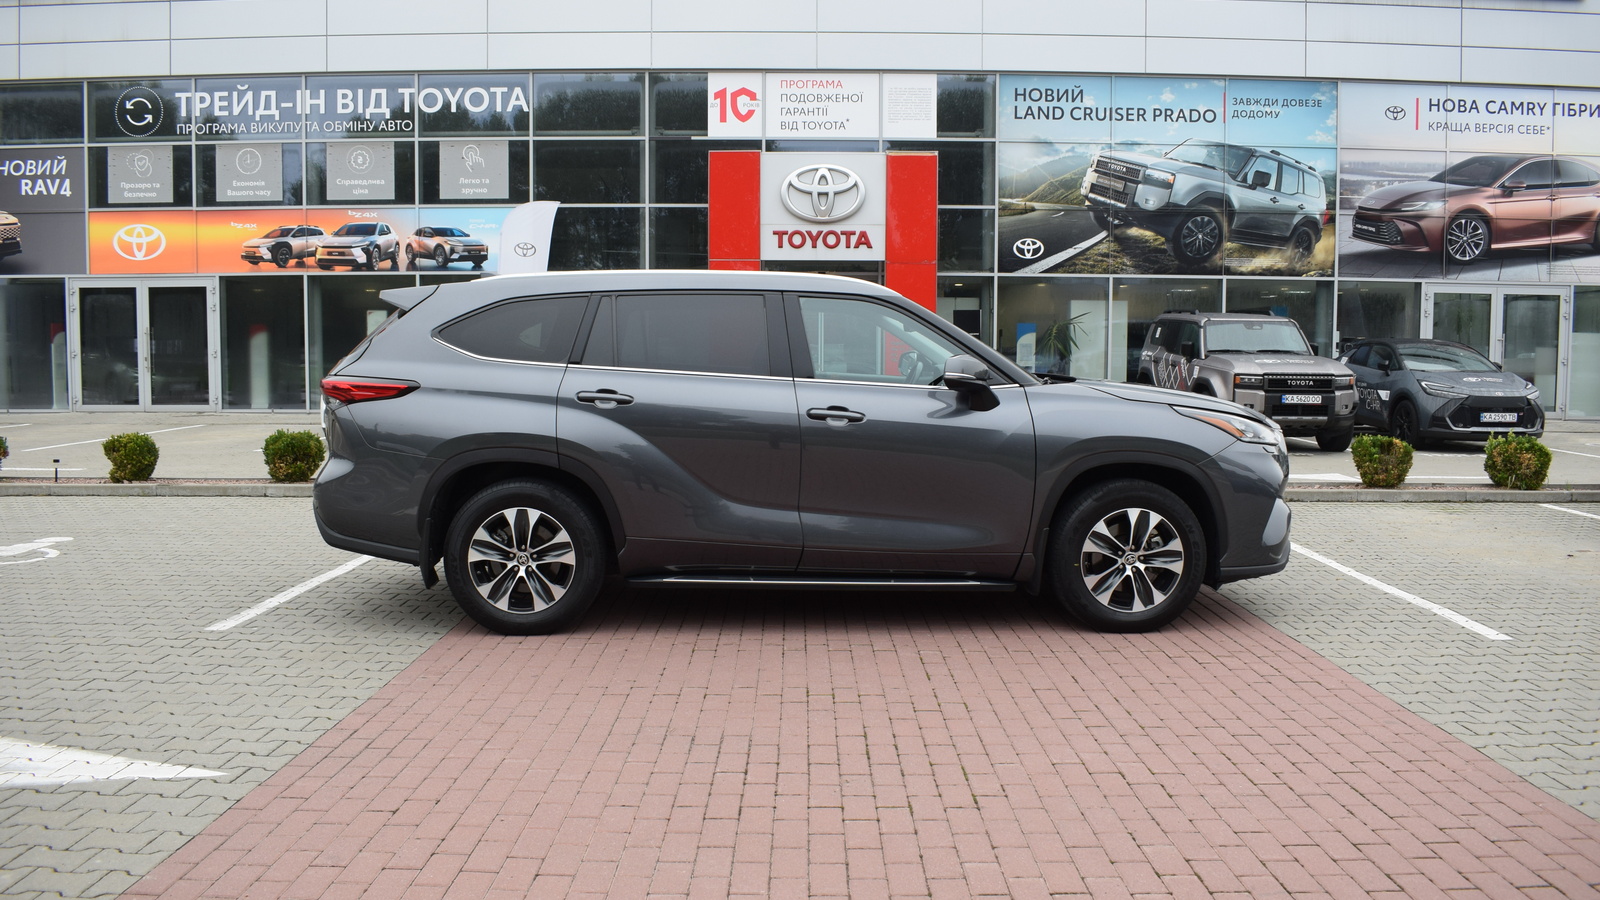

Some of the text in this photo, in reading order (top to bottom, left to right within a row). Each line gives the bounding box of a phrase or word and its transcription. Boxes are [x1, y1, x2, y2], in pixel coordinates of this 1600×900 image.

[780, 79, 844, 89] ПРОГРАМА
[780, 91, 864, 104] ПОДОВЖЕНОЇ
[1014, 84, 1084, 103] НОВИЙ
[175, 84, 530, 121] ТРЕЙД-ІН ВІД TOYOTA
[713, 86, 758, 123] 10
[1231, 97, 1323, 109] ЗАВЖДИ ДОВЕЗЕ
[1428, 97, 1480, 114] НОВА
[1485, 99, 1548, 116] CAMRY
[780, 105, 829, 117] ГАРАНТІЇ
[1014, 105, 1217, 124] LAND CRUISER PRADO
[1231, 109, 1281, 120] ДОДОМУ
[176, 118, 413, 135] ПРОГРАМА ВИКУПУ ТА ОБМІНУ АВТО
[780, 120, 799, 132] ВІД
[1428, 121, 1471, 134] КРАЩА
[1475, 123, 1514, 134] ВЕРСІЯ
[1107, 163, 1127, 172] TOYOTA
[20, 178, 72, 197] RAV4
[120, 182, 151, 190] Прозоро
[232, 180, 266, 188] Економія
[336, 178, 385, 187] Справедлива
[458, 177, 480, 186] Легко
[123, 191, 157, 199] безпечно
[227, 189, 254, 197] Вашого
[352, 188, 369, 196] ціна
[461, 187, 488, 195] зручно
[772, 229, 873, 249] TOYOTA
[1285, 395, 1295, 403] KA
[1296, 395, 1311, 403] 5620
[1356, 387, 1379, 400] TOYOTA
[1365, 399, 1381, 411] C-HR
[1484, 412, 1493, 421] KA
[1493, 412, 1507, 421] 2590
